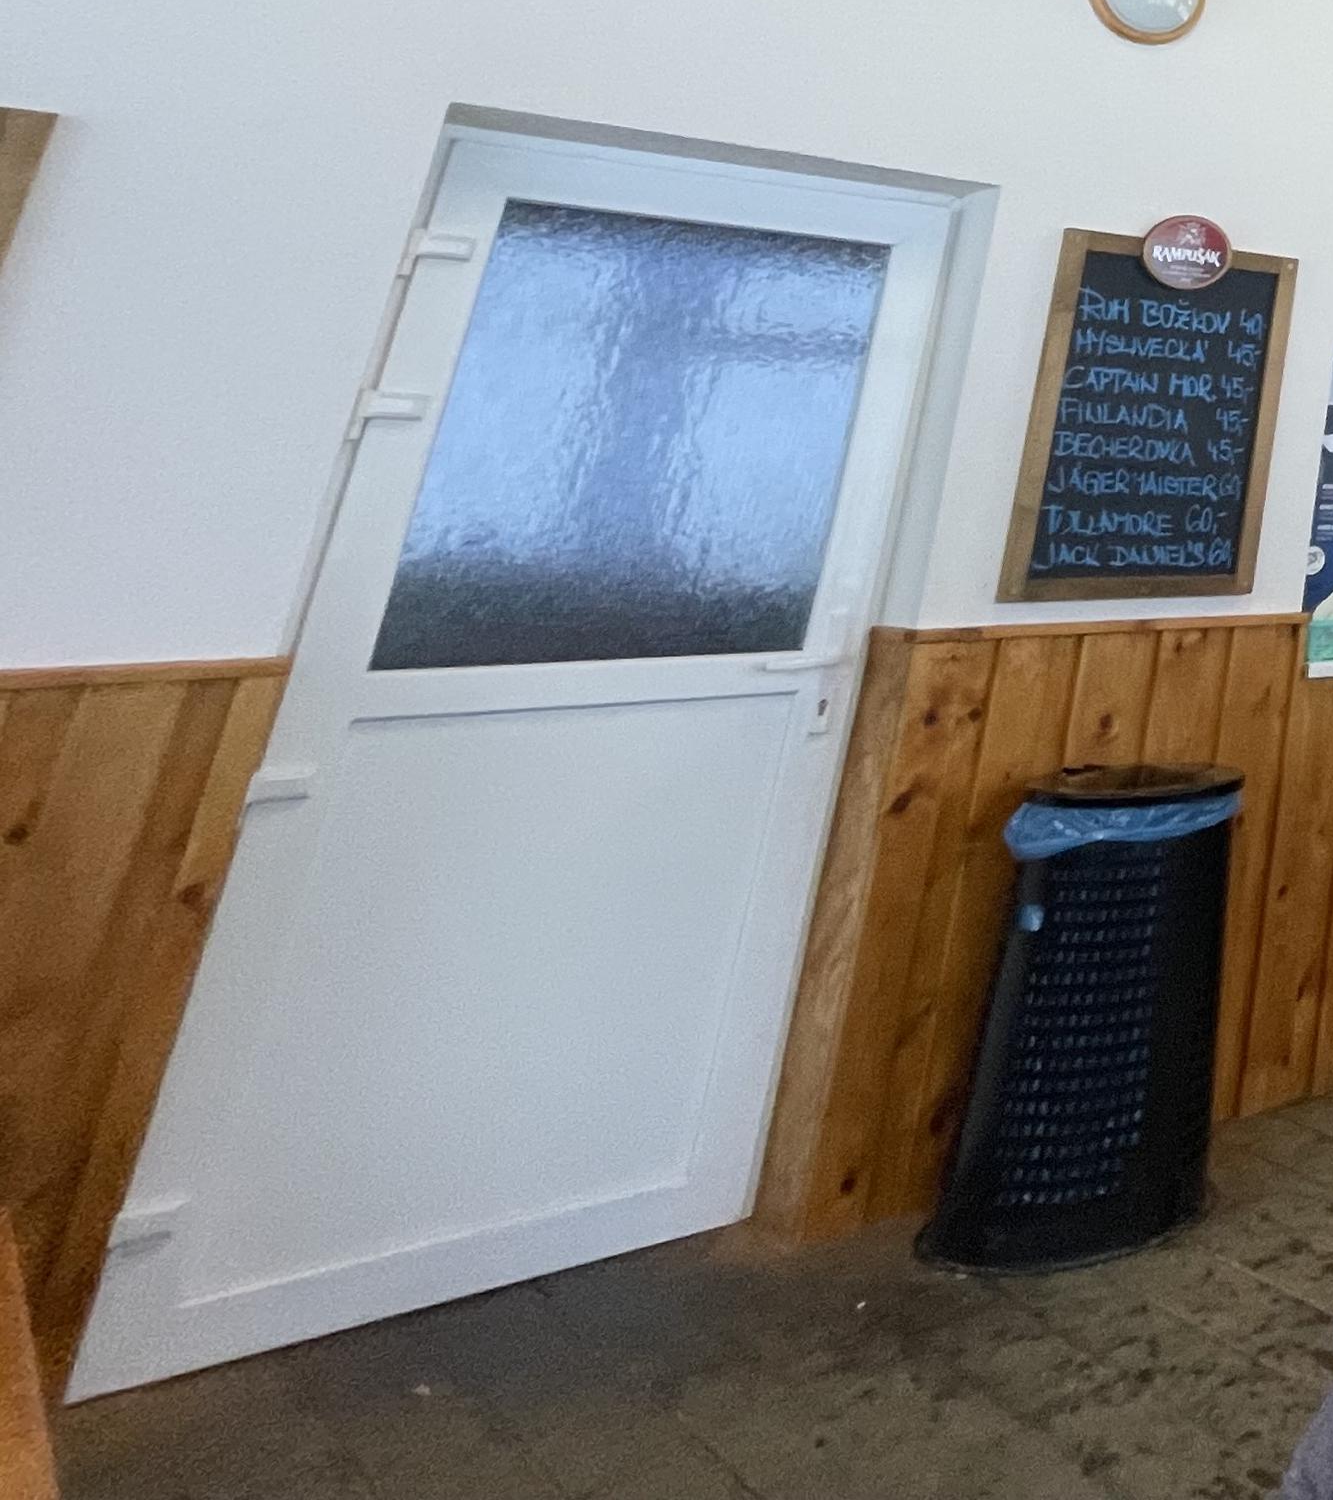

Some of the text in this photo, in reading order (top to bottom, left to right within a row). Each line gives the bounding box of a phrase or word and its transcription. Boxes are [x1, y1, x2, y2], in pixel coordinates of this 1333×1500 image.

[1078, 286, 1130, 324] RUM
[1139, 298, 1232, 334] BOŽKOV
[1062, 365, 1160, 396] CAPTAIN
[1059, 397, 1189, 435] FINLANDIA
[1053, 430, 1197, 467] BECHEROVKA
[1040, 504, 1175, 537] TULLAMORE
[1031, 541, 1101, 570] JACK
